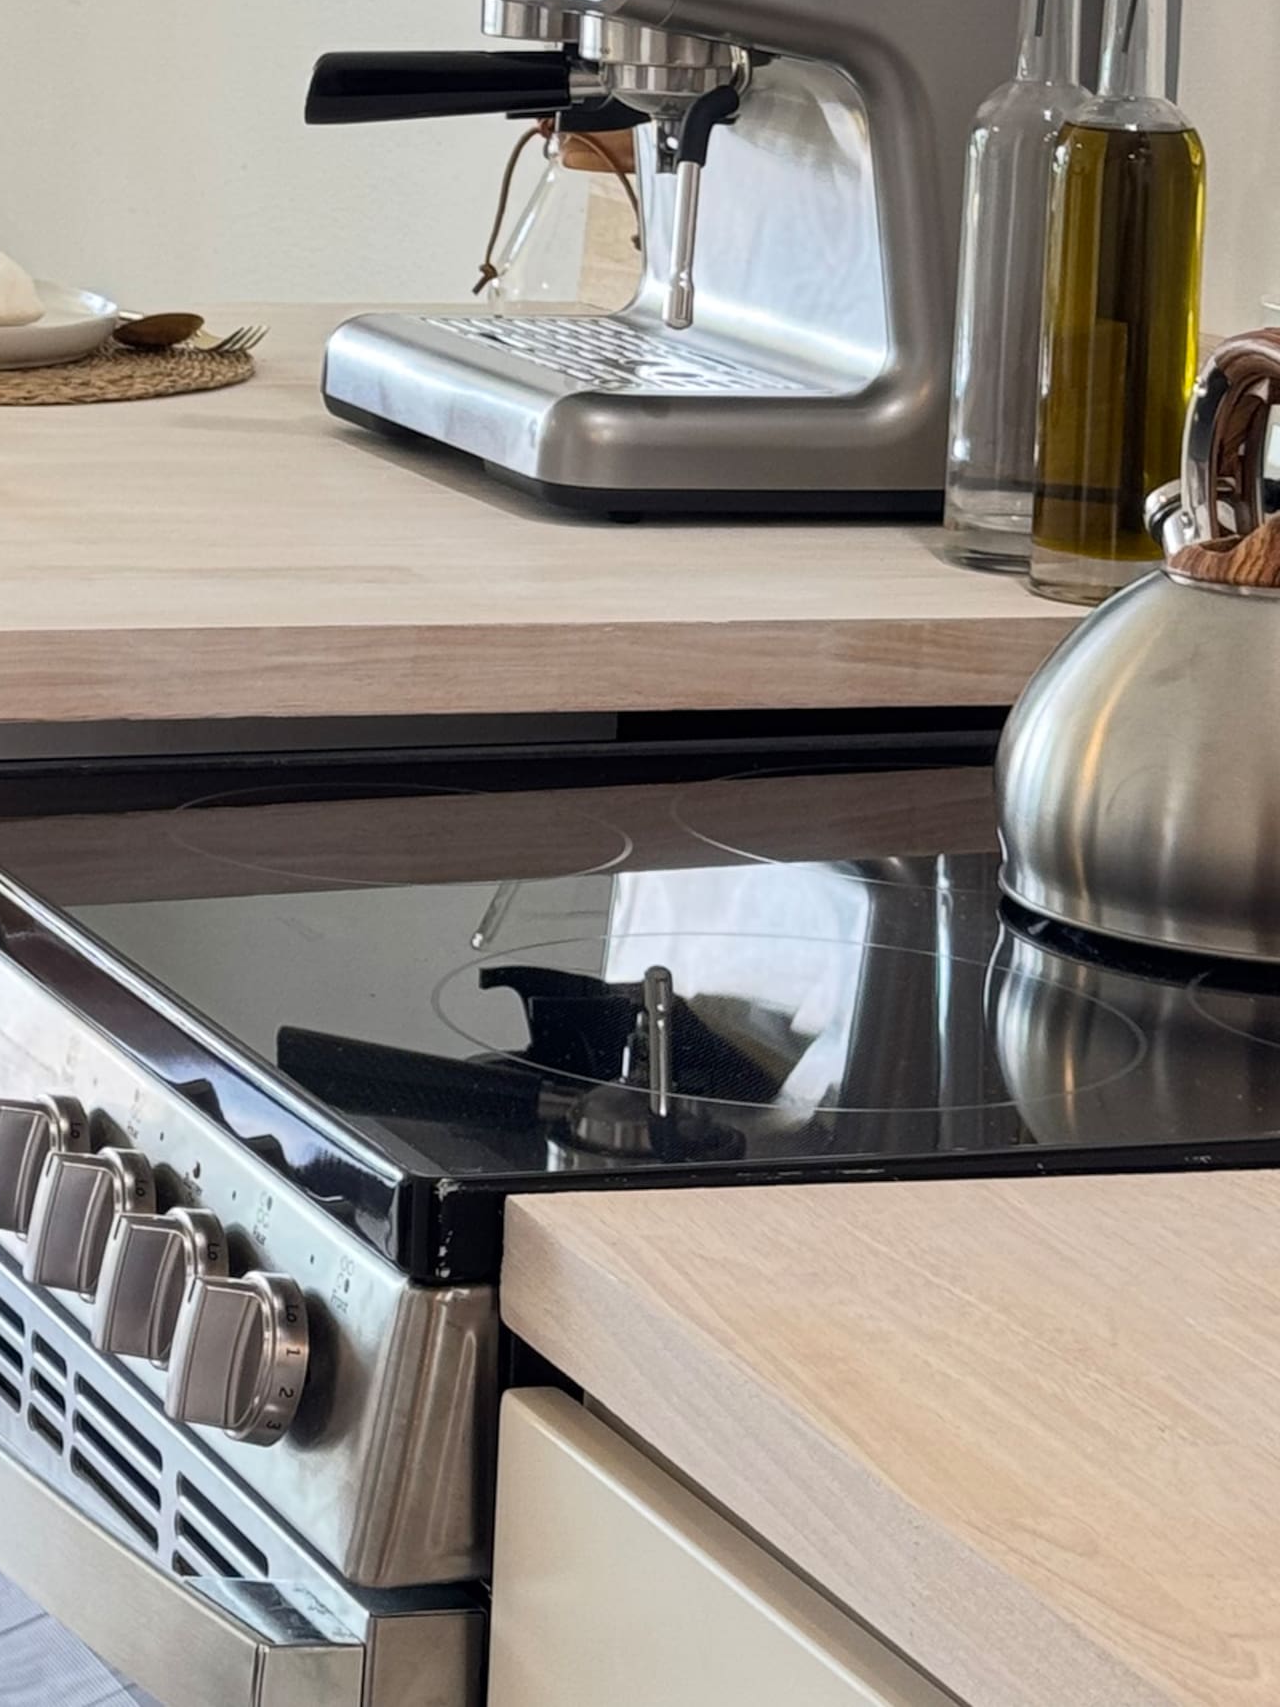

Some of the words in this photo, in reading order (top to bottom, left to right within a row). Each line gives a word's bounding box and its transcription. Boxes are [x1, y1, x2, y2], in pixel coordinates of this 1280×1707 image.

[207, 1242, 220, 1261] Lo
[286, 1303, 299, 1323] Lo
[286, 1347, 301, 1357] 1
[278, 1387, 294, 1399] 2
[266, 1420, 282, 1431] 3
